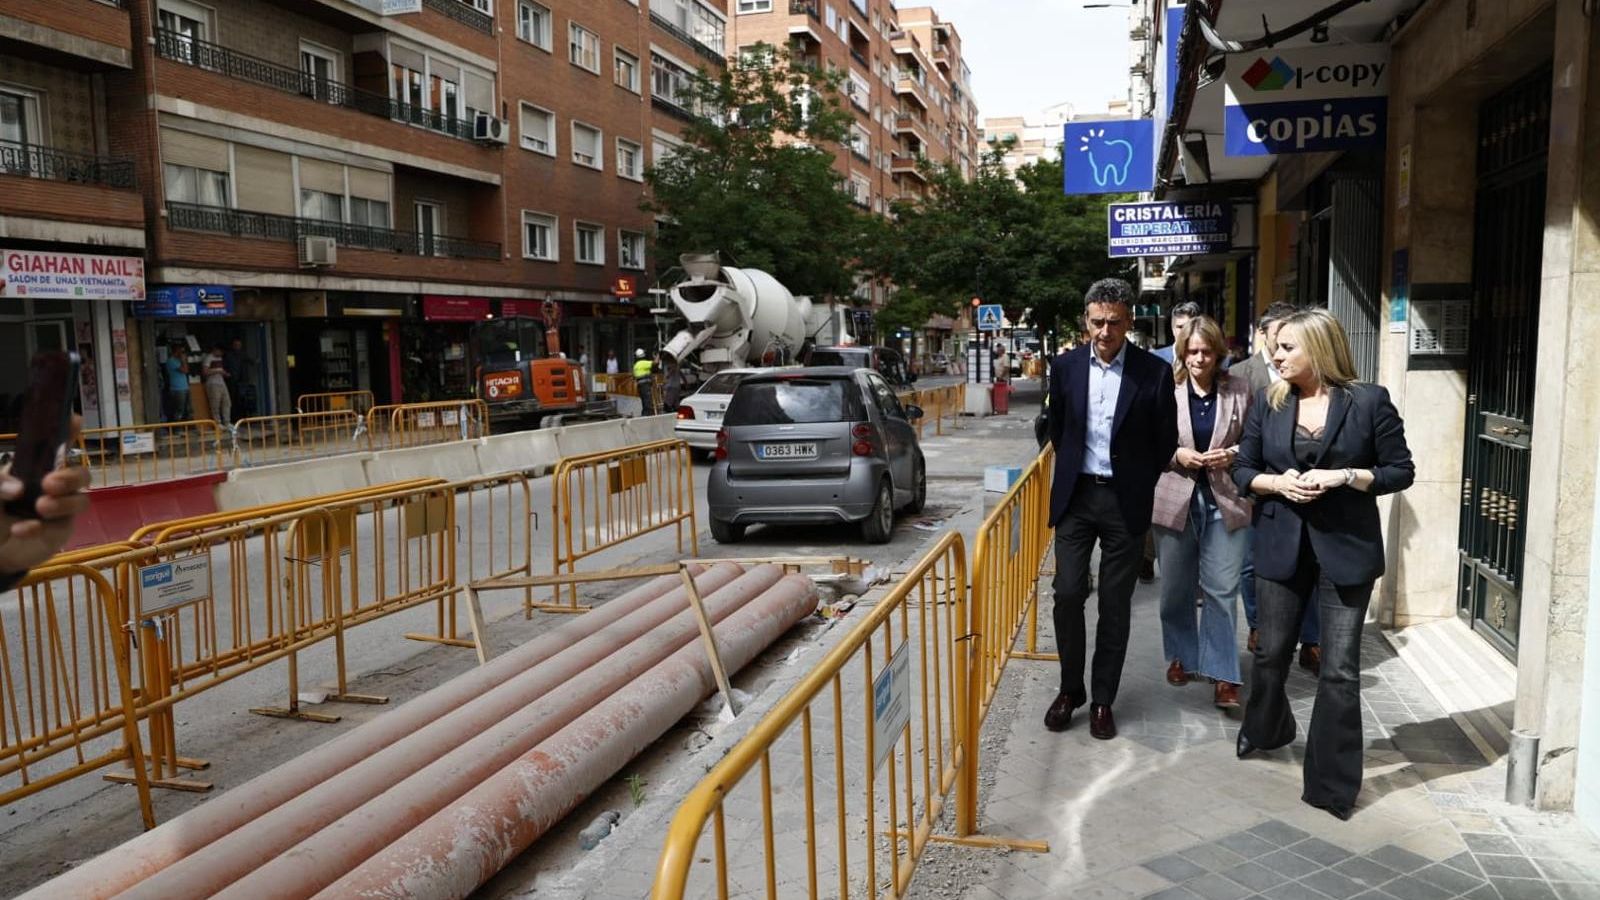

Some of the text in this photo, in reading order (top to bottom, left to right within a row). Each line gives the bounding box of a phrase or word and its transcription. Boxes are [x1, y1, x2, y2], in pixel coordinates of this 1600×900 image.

[1114, 200, 1222, 222] CRISTALERÍA
[7, 253, 133, 277] GIAHAN NAIL
[39, 275, 51, 284] DE
[79, 277, 126, 287] VIETNAMITA
[485, 376, 519, 386] HITACHI
[765, 445, 815, 456] 0363 HWK
